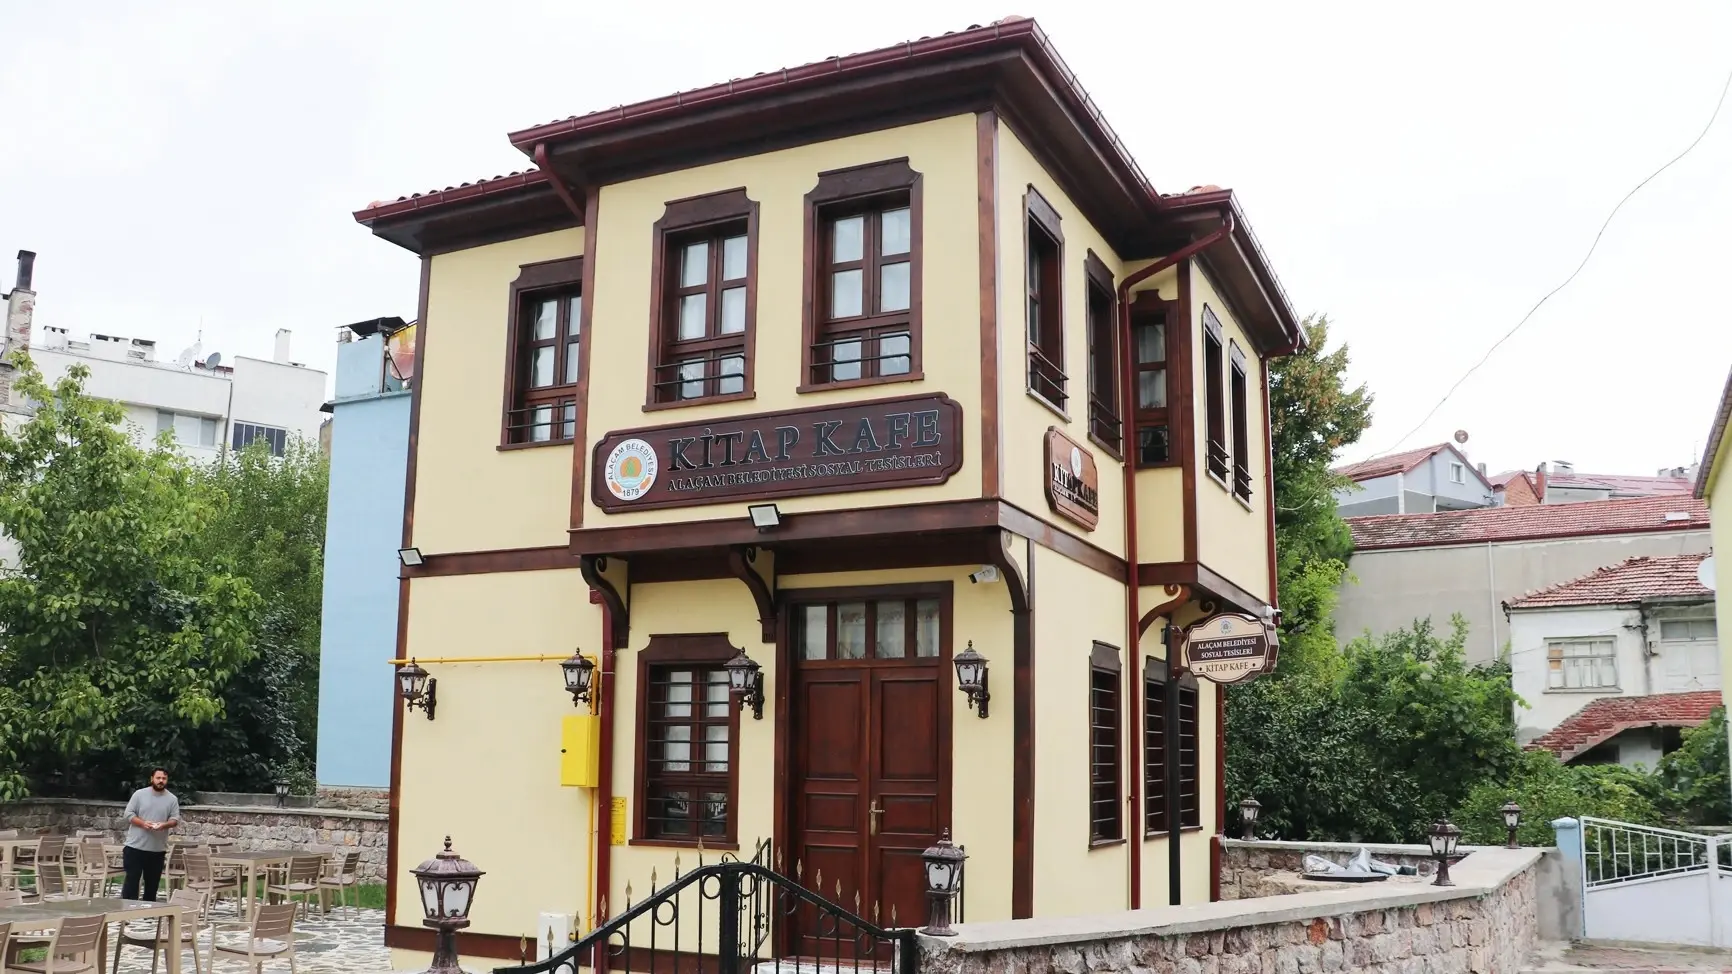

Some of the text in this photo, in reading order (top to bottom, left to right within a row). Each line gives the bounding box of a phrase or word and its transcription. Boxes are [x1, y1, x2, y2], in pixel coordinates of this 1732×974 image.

[667, 409, 942, 472] KİTAP KAFE
[668, 450, 942, 491] ALAÇAM BELEDİYESİ SOSYAL TESİSLERİ
[622, 488, 640, 497] 1879
[1198, 637, 1256, 650] ALAÇAM BELEDİYESİ
[1201, 647, 1253, 658] SOSYAL TESİSLERİ
[1206, 662, 1248, 672] KİTAP KAFE
